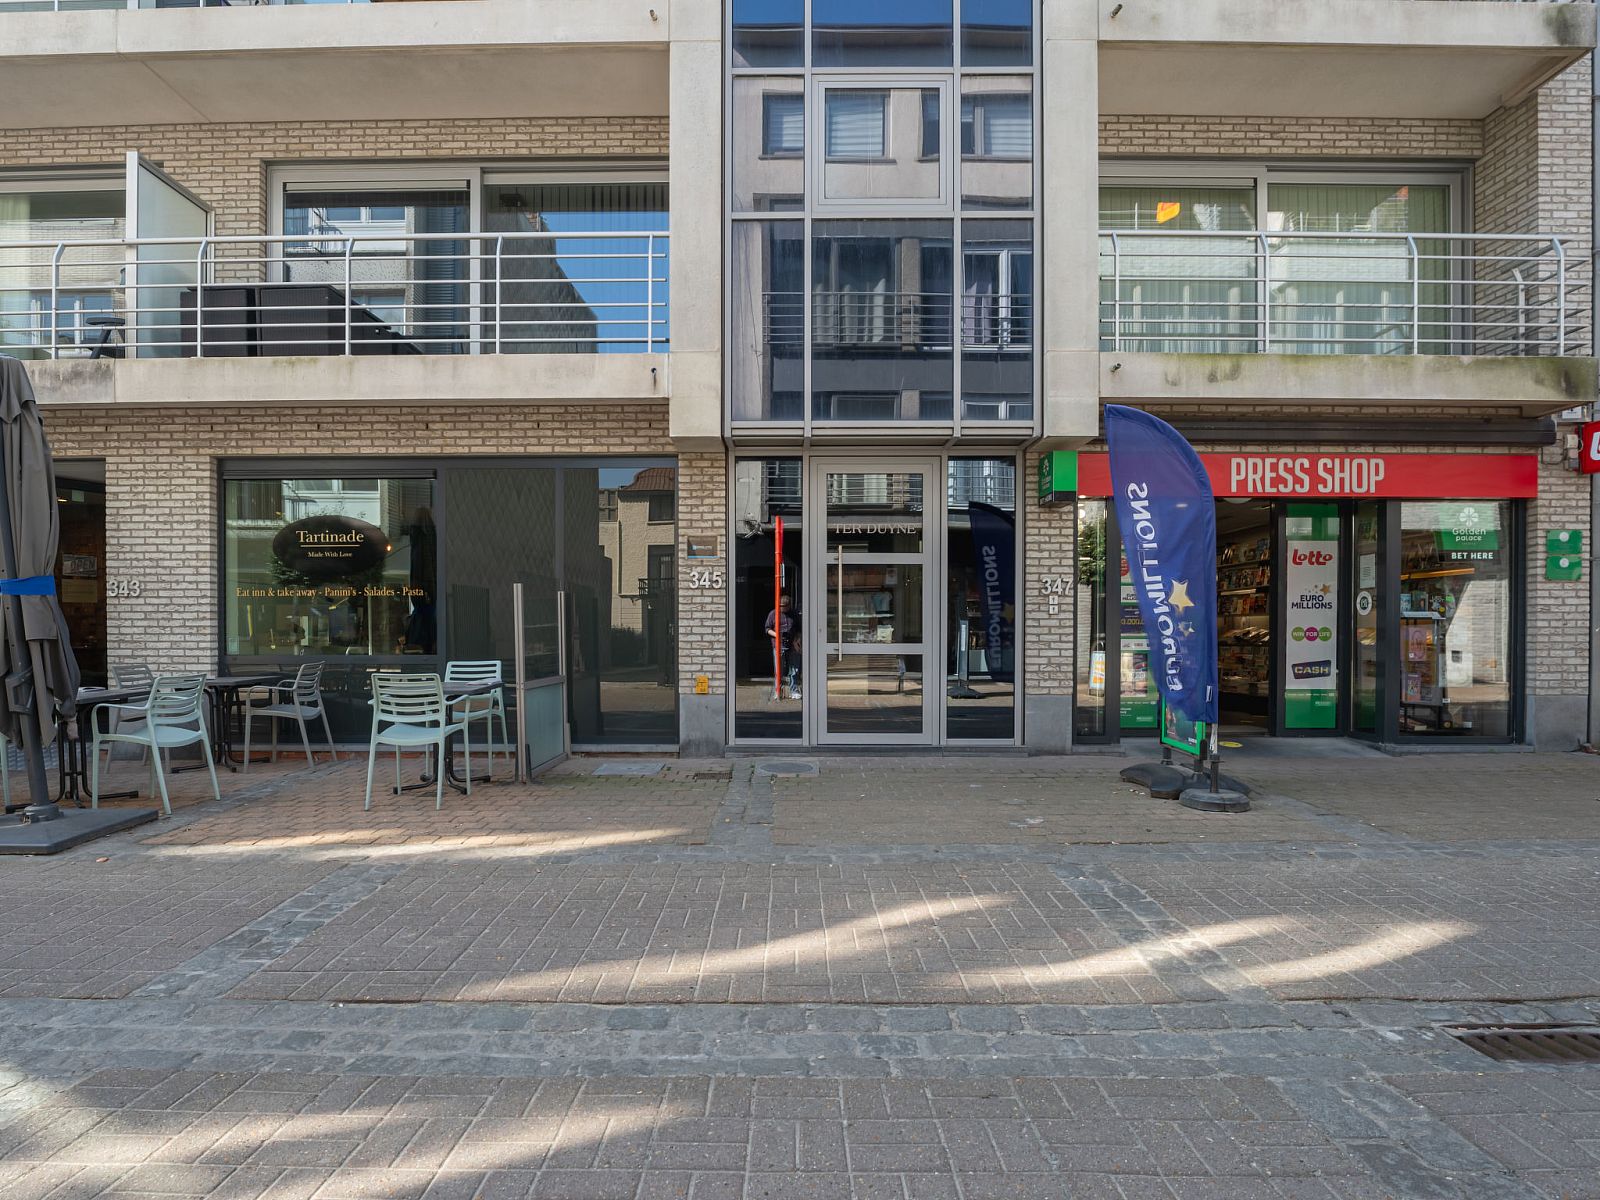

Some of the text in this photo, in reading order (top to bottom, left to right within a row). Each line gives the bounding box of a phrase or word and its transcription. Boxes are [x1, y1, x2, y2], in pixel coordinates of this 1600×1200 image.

[1230, 457, 1385, 493] PRESS SHOP
[835, 523, 917, 534] TER DUYNE
[1452, 527, 1487, 536] Golden
[295, 530, 364, 543] Tartinade
[1455, 534, 1482, 542] palace
[70, 559, 96, 570] OPEN
[689, 571, 722, 589] 345
[108, 580, 140, 597] 343
[1041, 577, 1073, 595] 347
[236, 588, 250, 597] Eat
[252, 588, 266, 597] inn
[267, 588, 274, 597] &
[277, 588, 294, 597] take
[296, 589, 316, 598] away
[324, 587, 356, 597] Panini's
[363, 587, 395, 597] Salades
[402, 587, 424, 597] Pasta
[1294, 666, 1329, 674] CASH
